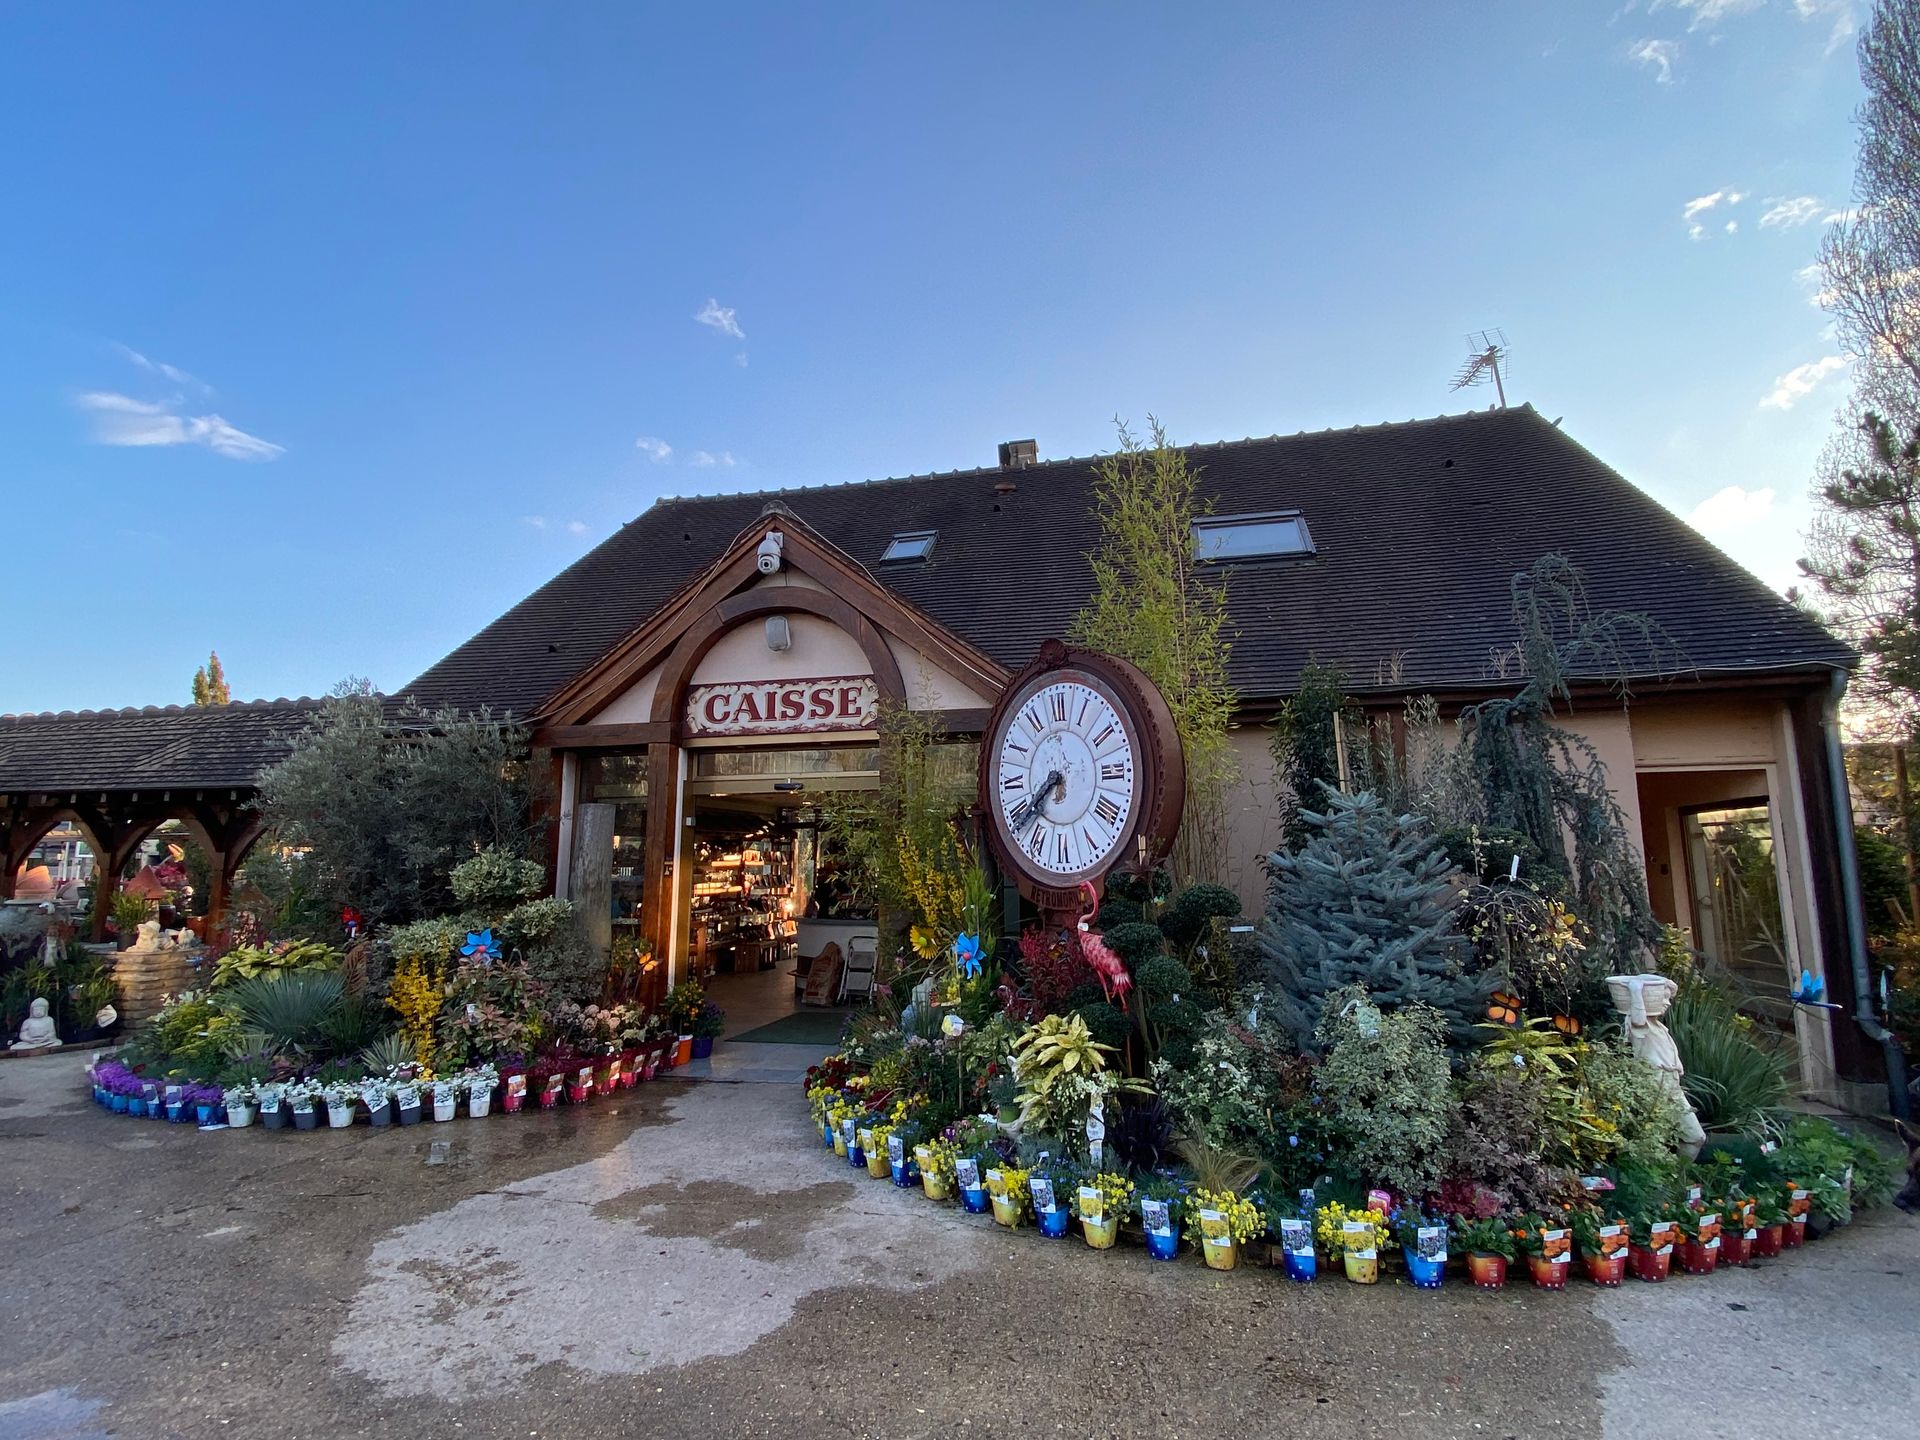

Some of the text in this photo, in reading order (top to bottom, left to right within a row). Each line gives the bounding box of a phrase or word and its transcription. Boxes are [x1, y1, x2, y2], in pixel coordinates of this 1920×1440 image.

[705, 686, 863, 724] CAISSE
[1049, 692, 1067, 723] XII
[1076, 697, 1090, 727] I
[1008, 737, 1029, 760] X
[1092, 721, 1115, 749] II
[1004, 774, 1024, 790] IX
[1057, 833, 1071, 863] VI
[1082, 825, 1099, 855] V
[1030, 885, 1086, 908] RETROMOBIL
